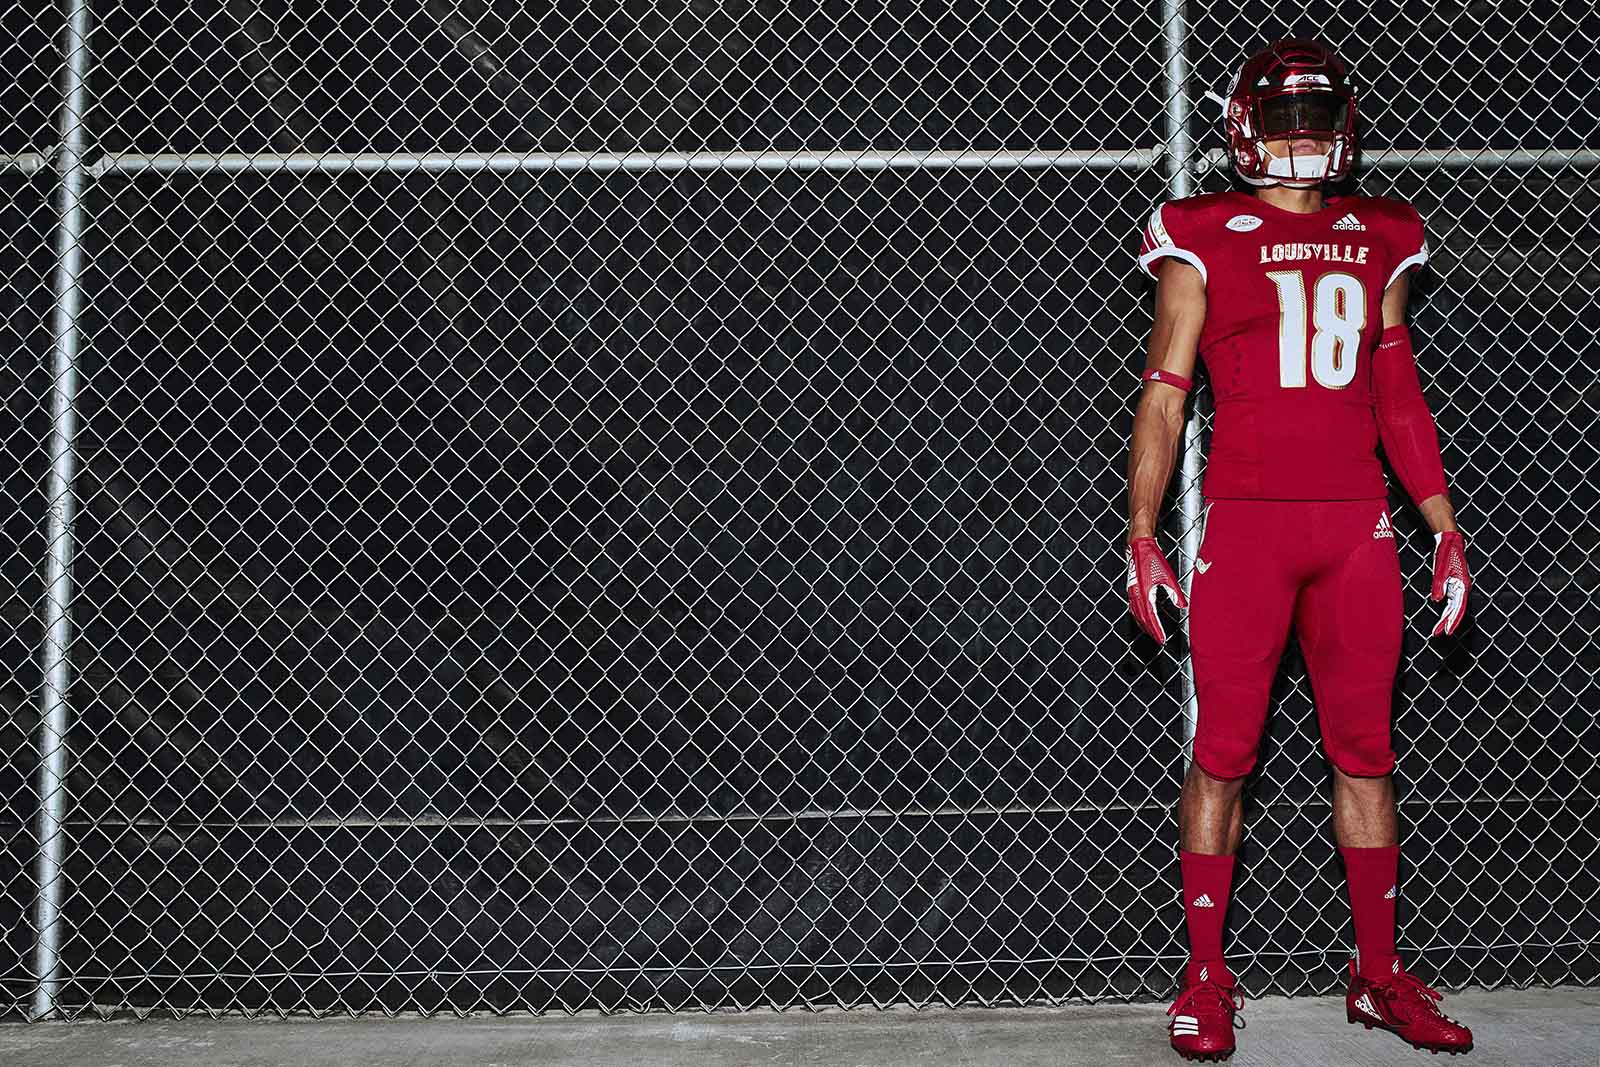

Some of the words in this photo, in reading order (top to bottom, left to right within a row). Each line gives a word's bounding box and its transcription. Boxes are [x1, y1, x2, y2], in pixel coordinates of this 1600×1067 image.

[1332, 223, 1367, 231] adidas
[1259, 243, 1369, 265] LOUISVILLE
[1265, 269, 1368, 390] 18
